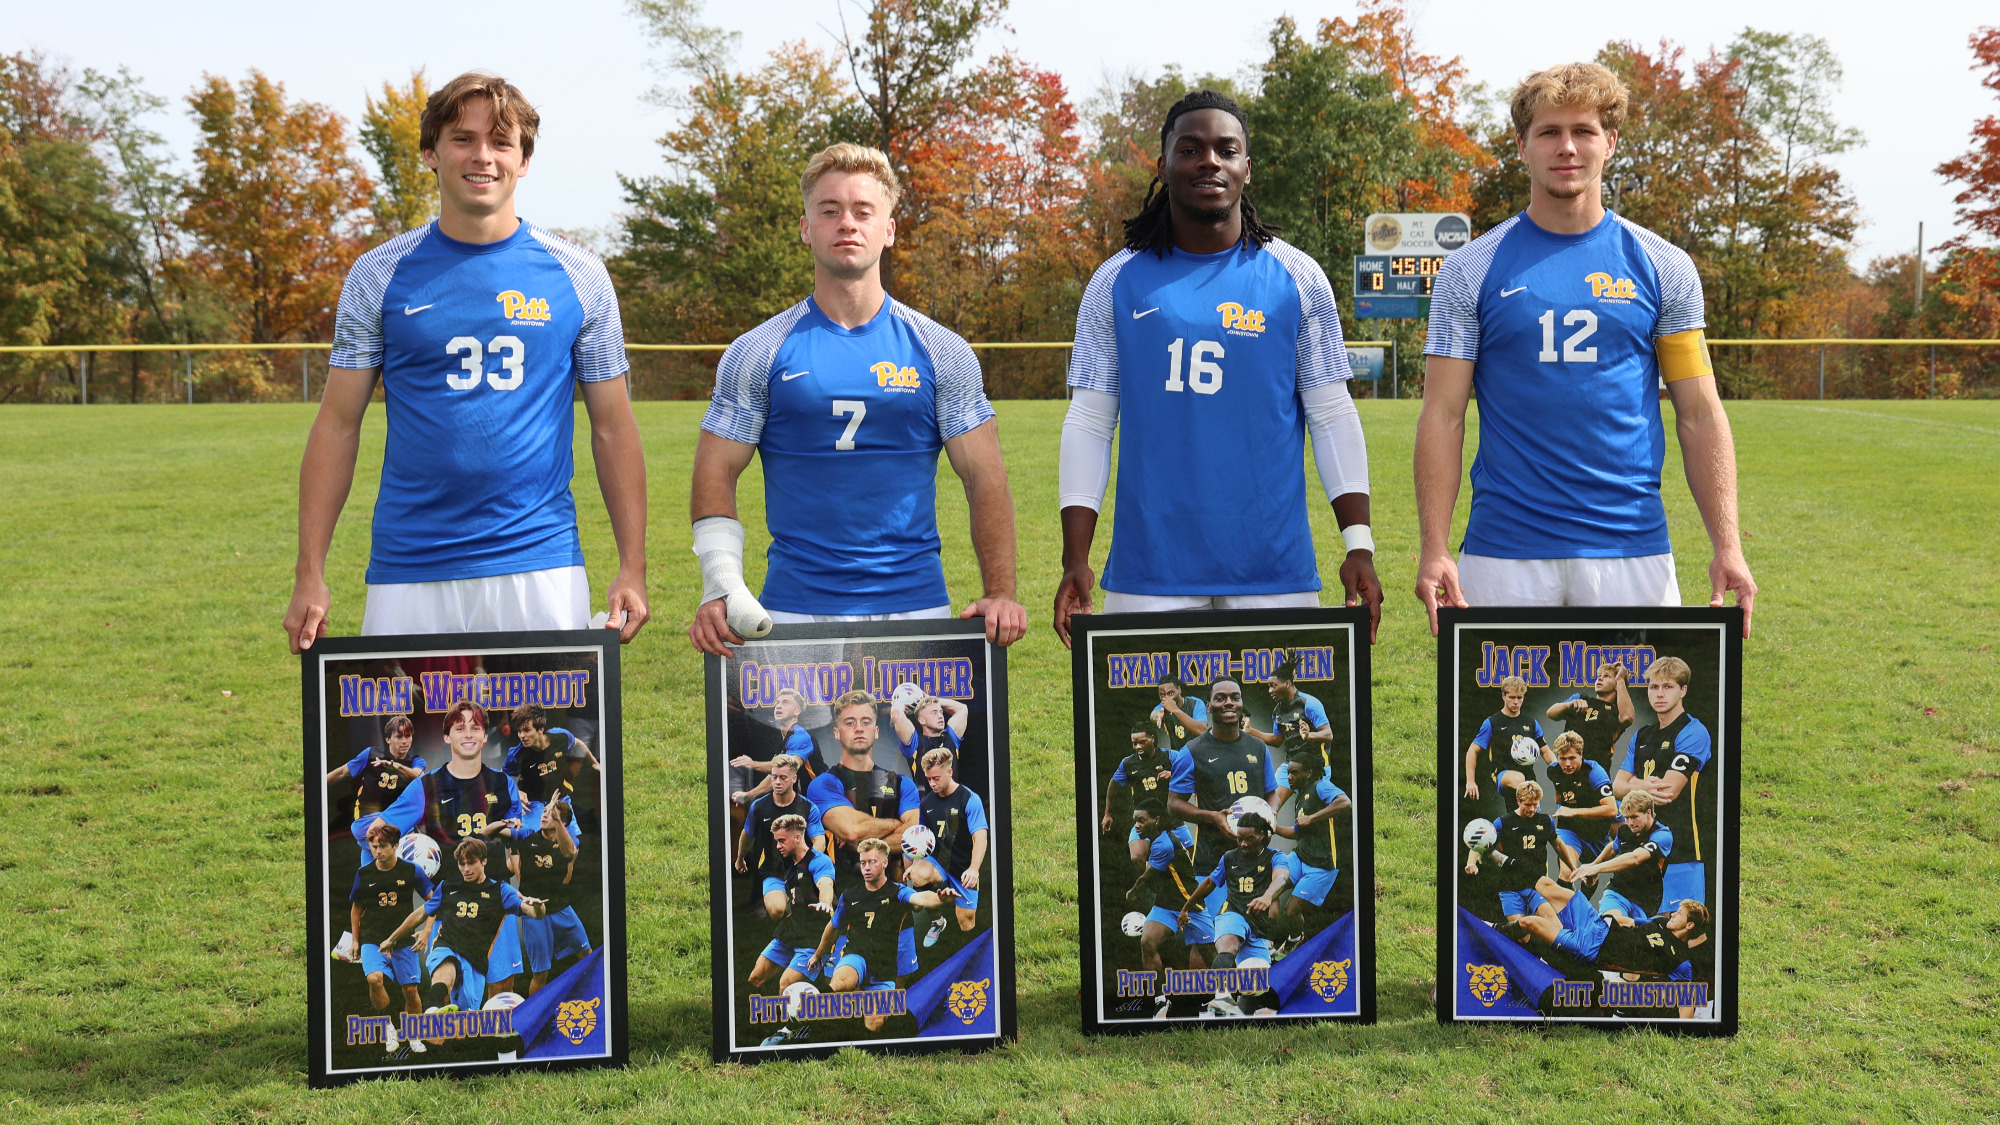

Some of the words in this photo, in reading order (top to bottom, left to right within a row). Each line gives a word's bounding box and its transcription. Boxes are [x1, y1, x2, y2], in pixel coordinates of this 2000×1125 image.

[1438, 232, 1468, 242] NCAA
[1360, 261, 1384, 272] HOME
[1372, 272, 1384, 290] 0
[1396, 281, 1417, 290] HALF
[1584, 272, 1636, 298] Pitt
[496, 290, 551, 321] Pitt
[1216, 302, 1266, 332] Pitt
[1226, 330, 1259, 338] JOHNSTOWN
[1538, 310, 1598, 362] 12
[446, 335, 524, 391] 33
[870, 361, 920, 388] Pitt
[1165, 338, 1225, 395] 16
[832, 400, 866, 450] 7
[1108, 652, 1170, 688] RYAN
[1476, 641, 1550, 688] JACK
[1559, 640, 1656, 688] MOYER
[340, 674, 414, 717] NOAH
[420, 670, 589, 714] WEICHBRODT
[740, 660, 854, 709] CONNOR
[863, 656, 974, 703] LUTHER
[1671, 754, 1690, 771] C
[378, 772, 398, 790] 33
[1142, 776, 1158, 791] 16
[1226, 770, 1248, 794] 16
[1600, 784, 1612, 796] C
[457, 812, 488, 837] 33
[936, 820, 946, 838] 7
[1522, 835, 1536, 849] 12
[1239, 876, 1254, 893] 16
[378, 892, 398, 907] 33
[456, 901, 479, 918] 33
[864, 912, 875, 929] 7
[1117, 968, 1157, 997] PITT
[1162, 968, 1270, 996] JOHNSTOWN
[1553, 978, 1594, 1008] PITT
[1598, 979, 1708, 1008] JOHNSTOWN
[749, 994, 790, 1024] PITT
[796, 988, 906, 1022] JOHNSTOWN
[347, 1014, 391, 1045] PITT
[396, 1009, 512, 1042] JOHNSTOWN
